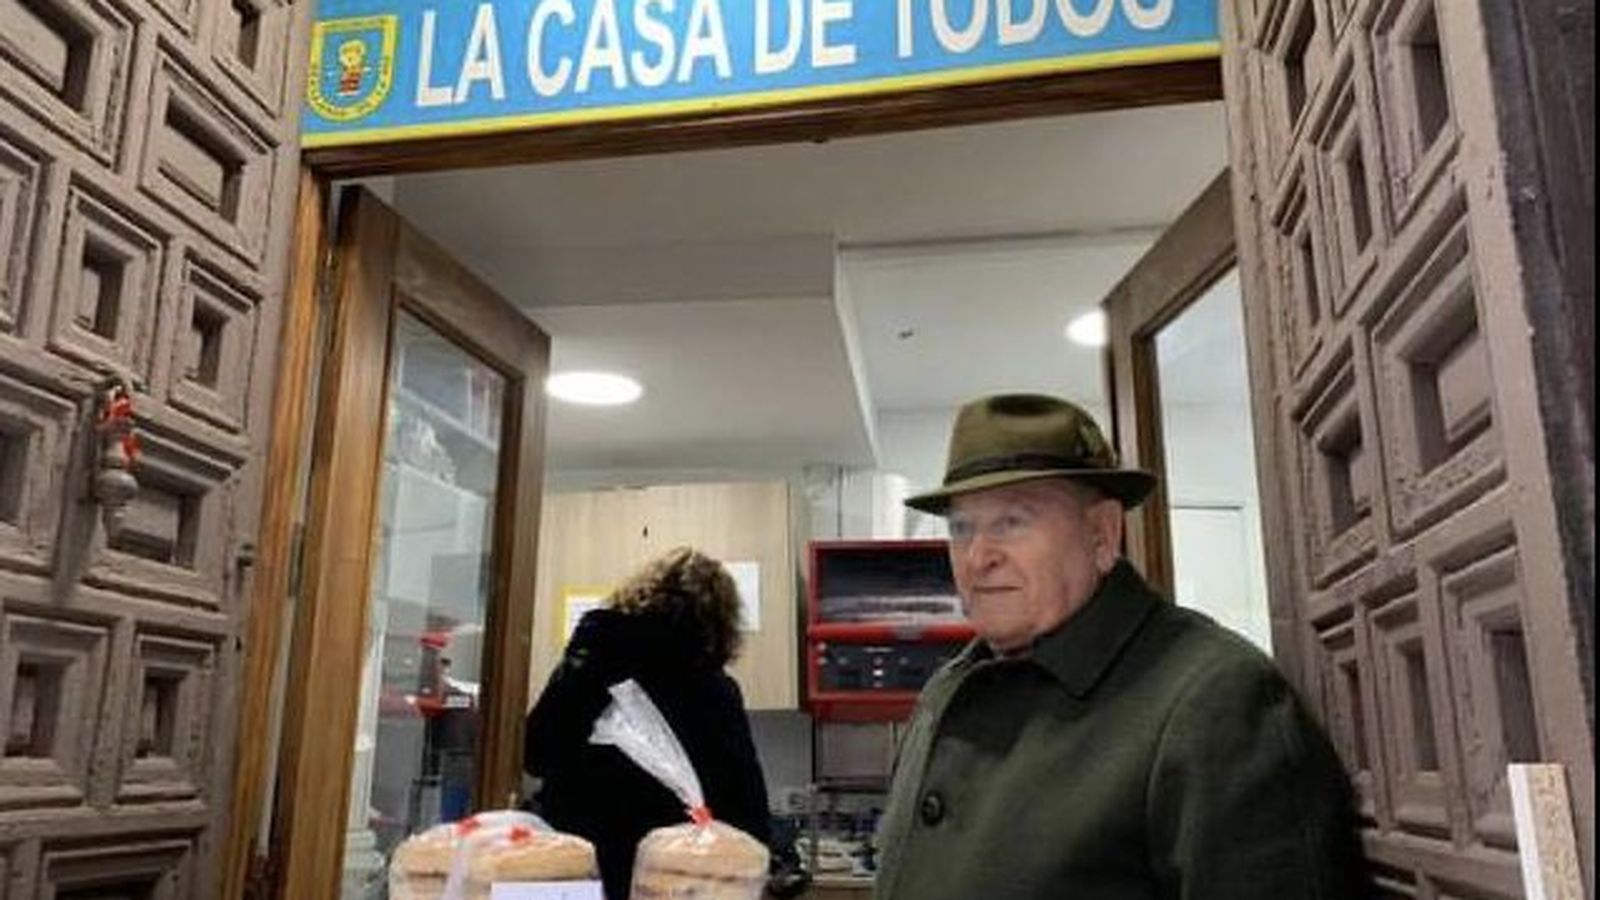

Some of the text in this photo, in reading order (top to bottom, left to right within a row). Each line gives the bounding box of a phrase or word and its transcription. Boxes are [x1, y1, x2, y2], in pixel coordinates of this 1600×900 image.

[415, 3, 505, 107] LA
[527, 0, 732, 97] CASA
[753, 0, 858, 75] DE
